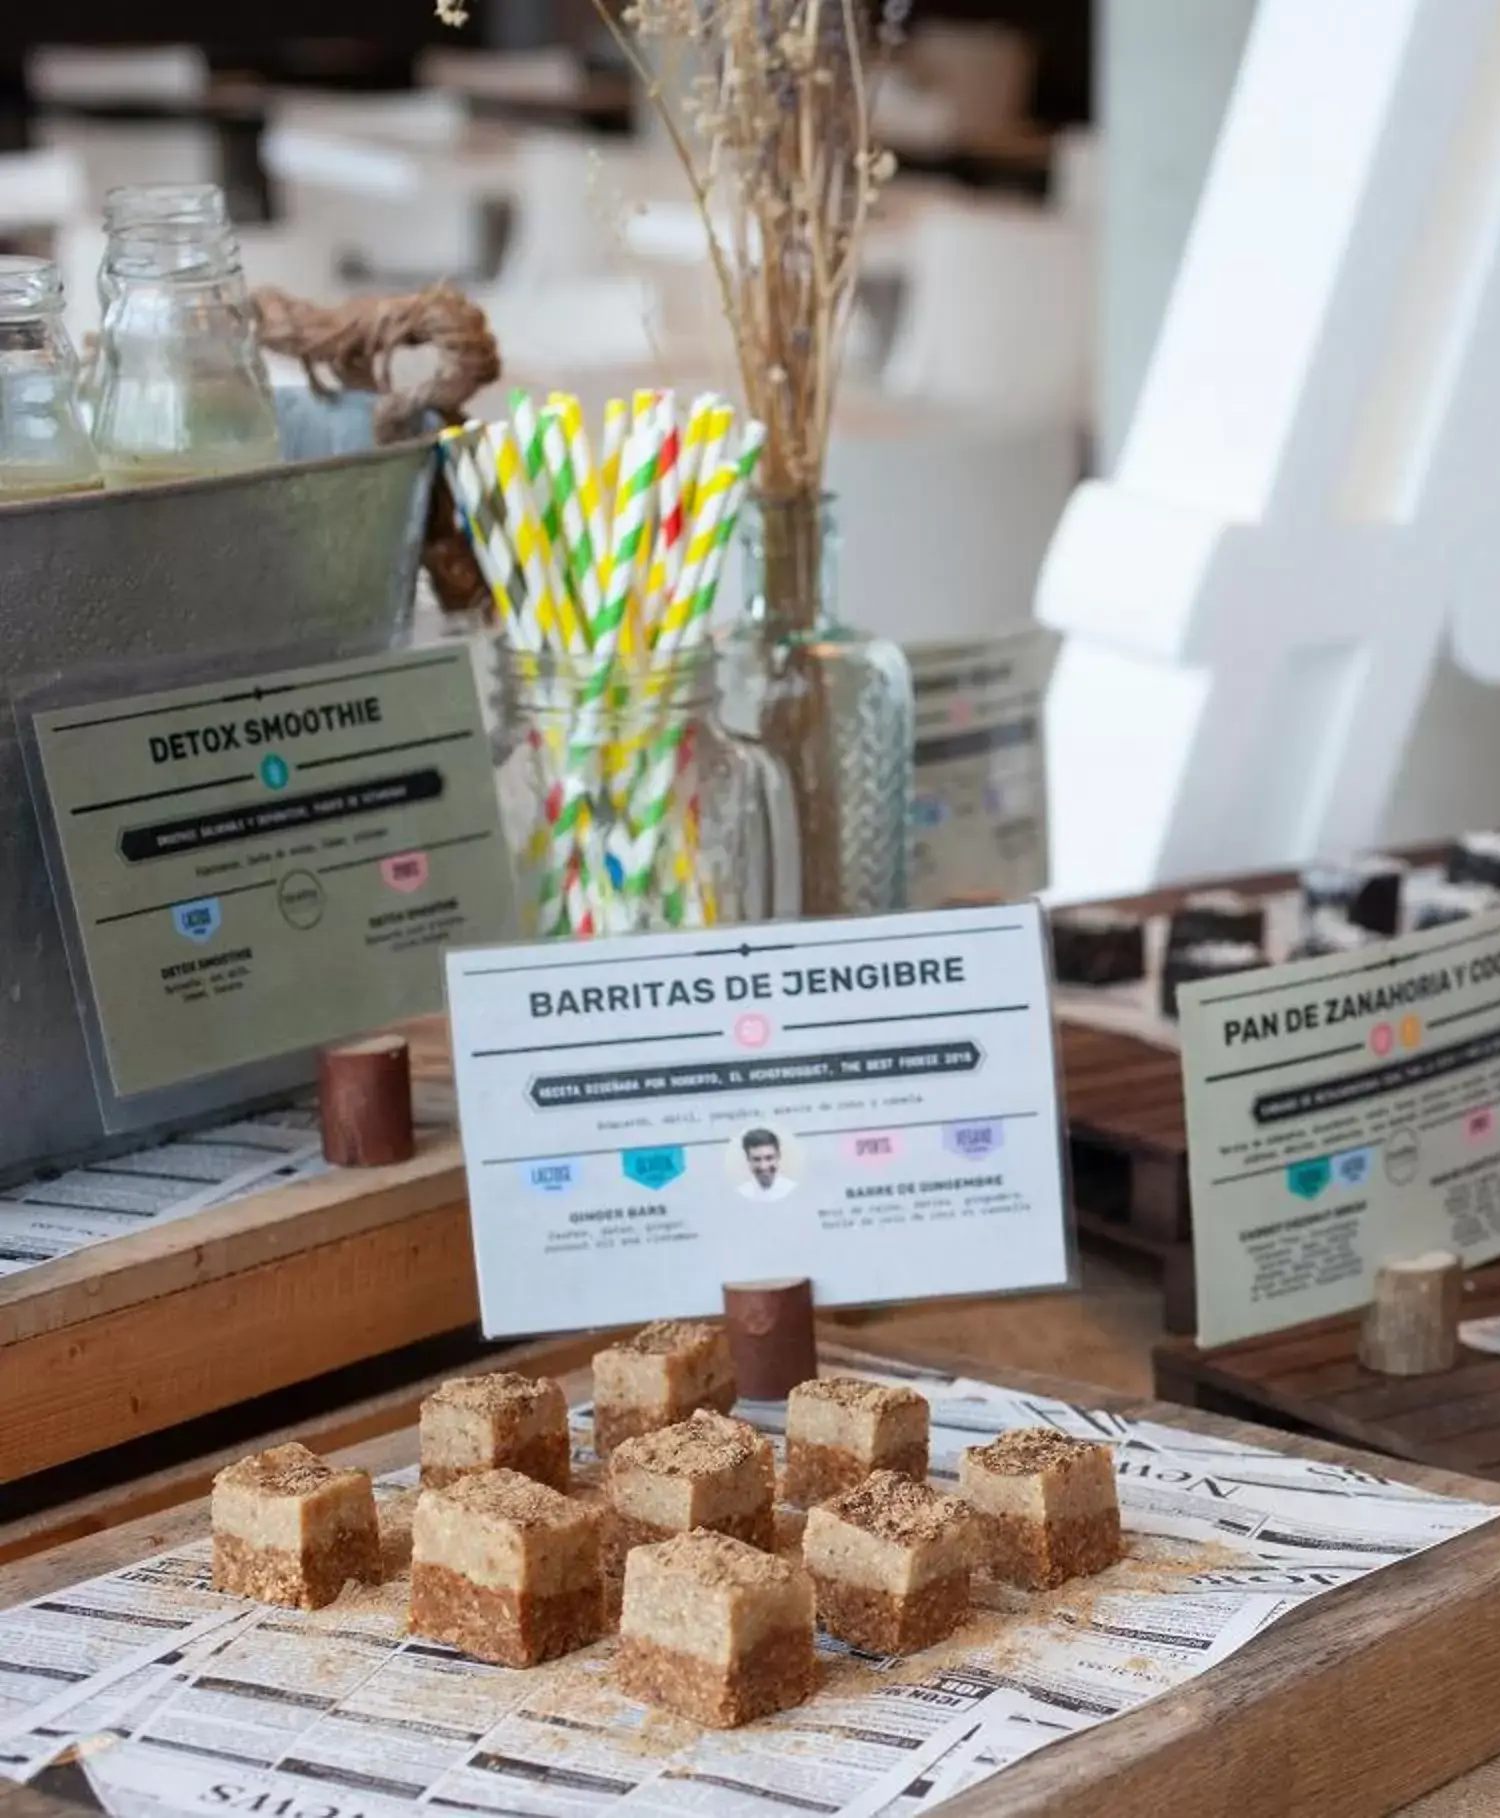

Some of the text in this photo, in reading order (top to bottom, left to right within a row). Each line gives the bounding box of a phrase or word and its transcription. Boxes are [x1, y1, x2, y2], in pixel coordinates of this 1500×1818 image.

[149, 697, 381, 764] DETOX SMOOTHIE
[529, 957, 965, 1018] BARRITAS DE JENGIBRE
[1224, 1012, 1279, 1046] PAN
[1285, 1004, 1319, 1033] DE
[1325, 969, 1451, 1025] ZANAHORIA
[1452, 963, 1467, 989] Y
[644, 1075, 666, 1089] POR
[730, 1071, 744, 1083] EL
[841, 1060, 862, 1074] THE
[866, 1058, 893, 1072] BEST
[1117, 1460, 1242, 1499] New
